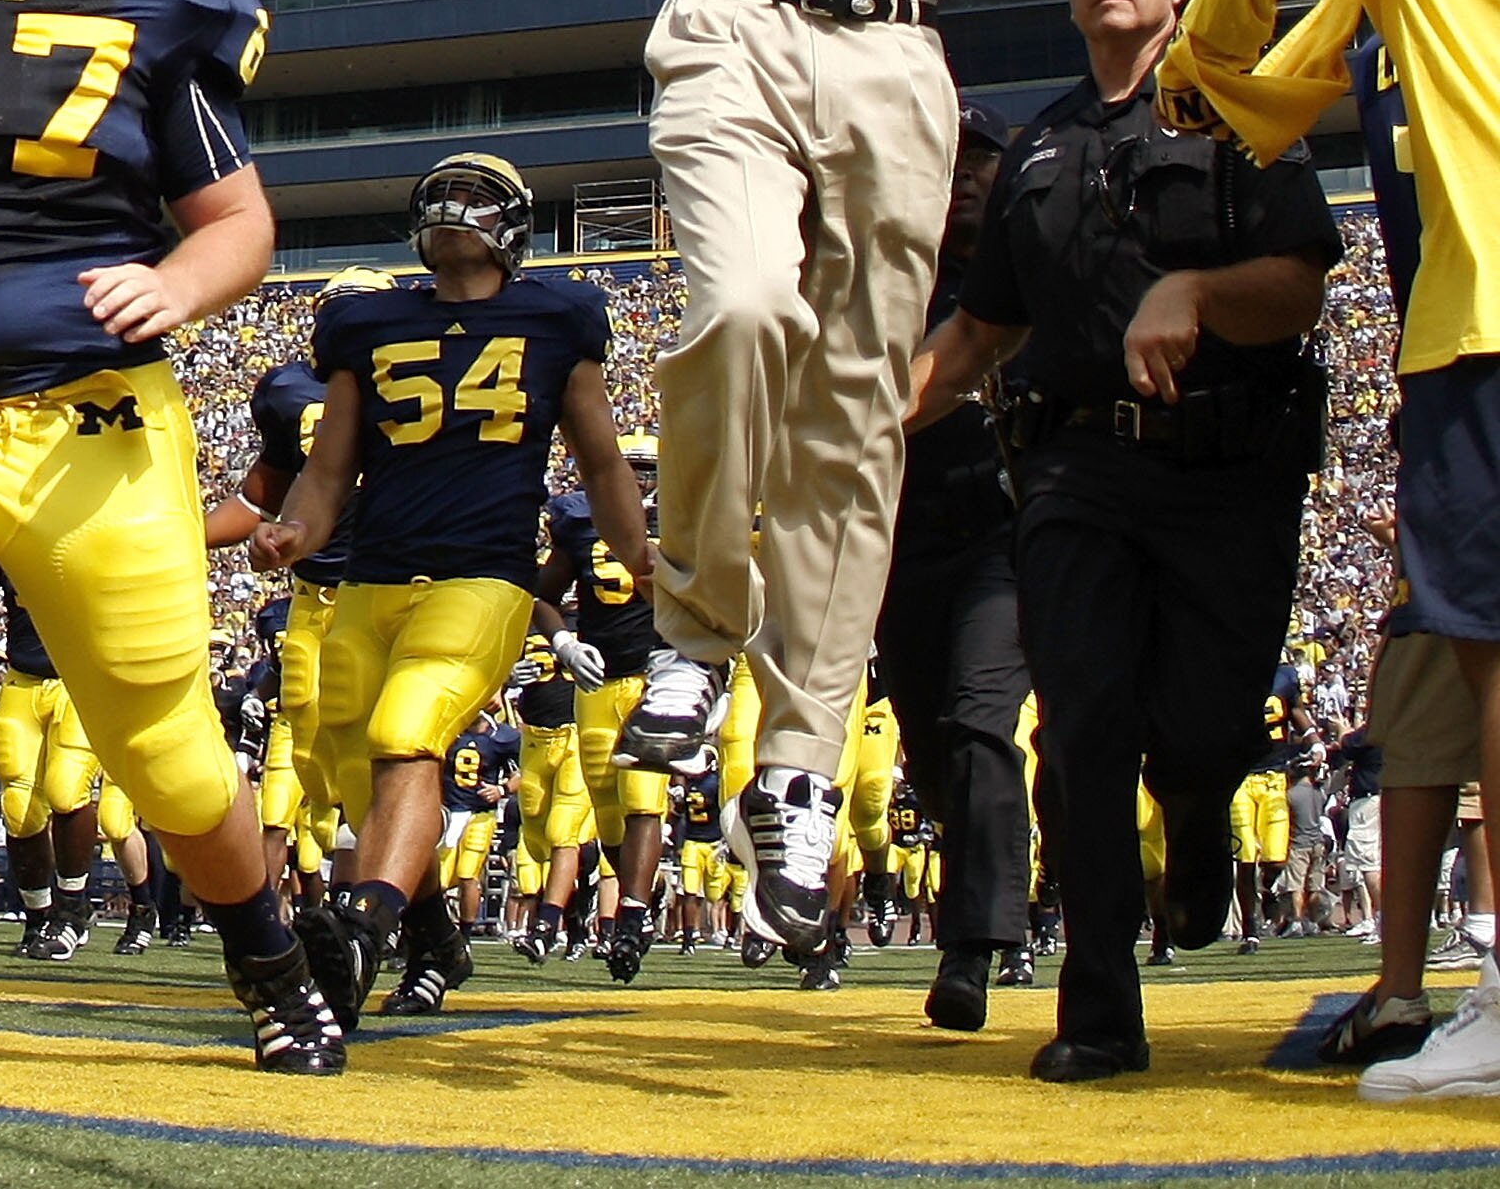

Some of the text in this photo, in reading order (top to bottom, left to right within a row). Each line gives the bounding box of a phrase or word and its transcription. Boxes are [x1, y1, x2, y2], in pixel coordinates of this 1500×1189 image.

[371, 337, 528, 447] 54
[74, 395, 147, 436] M
[864, 723, 881, 736] M
[454, 746, 482, 788] 8
[686, 790, 709, 823] 2
